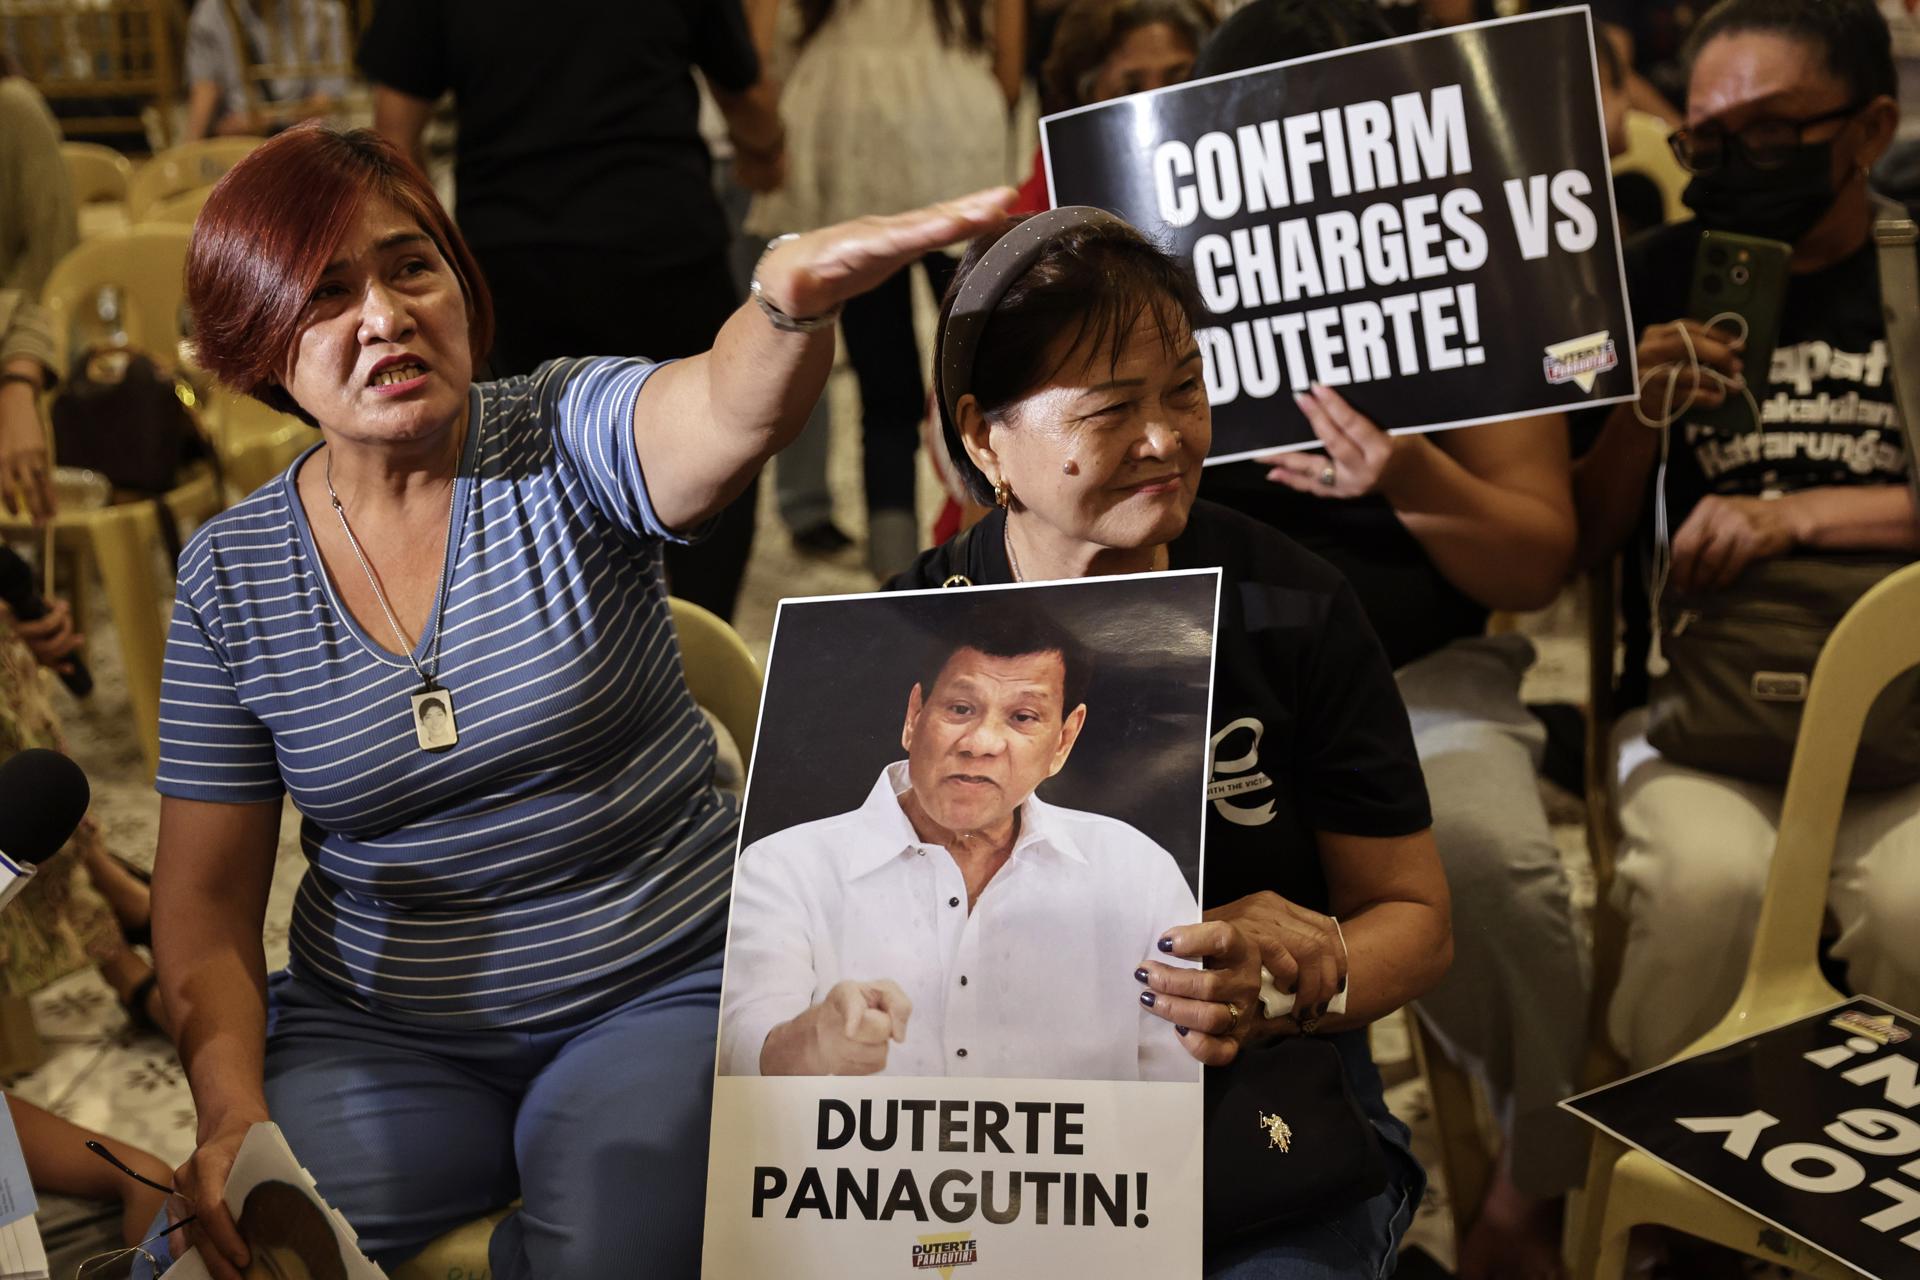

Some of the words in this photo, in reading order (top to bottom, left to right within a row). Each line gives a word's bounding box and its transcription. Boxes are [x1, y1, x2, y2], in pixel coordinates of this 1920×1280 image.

[1153, 84, 1472, 228] CONFIRM
[1192, 188, 1488, 314] CHARGES
[1504, 169, 1598, 260] VS
[1193, 283, 1486, 407] DUTERTE!
[1227, 782, 1243, 792] THE
[817, 1098, 1085, 1155] DUTERTE
[752, 1166, 1149, 1229] PANAGUTIN!
[1675, 1110, 1920, 1252] LOY
[912, 1240, 977, 1254] DUTERTE
[917, 1251, 973, 1265] PANAGUTIN!
